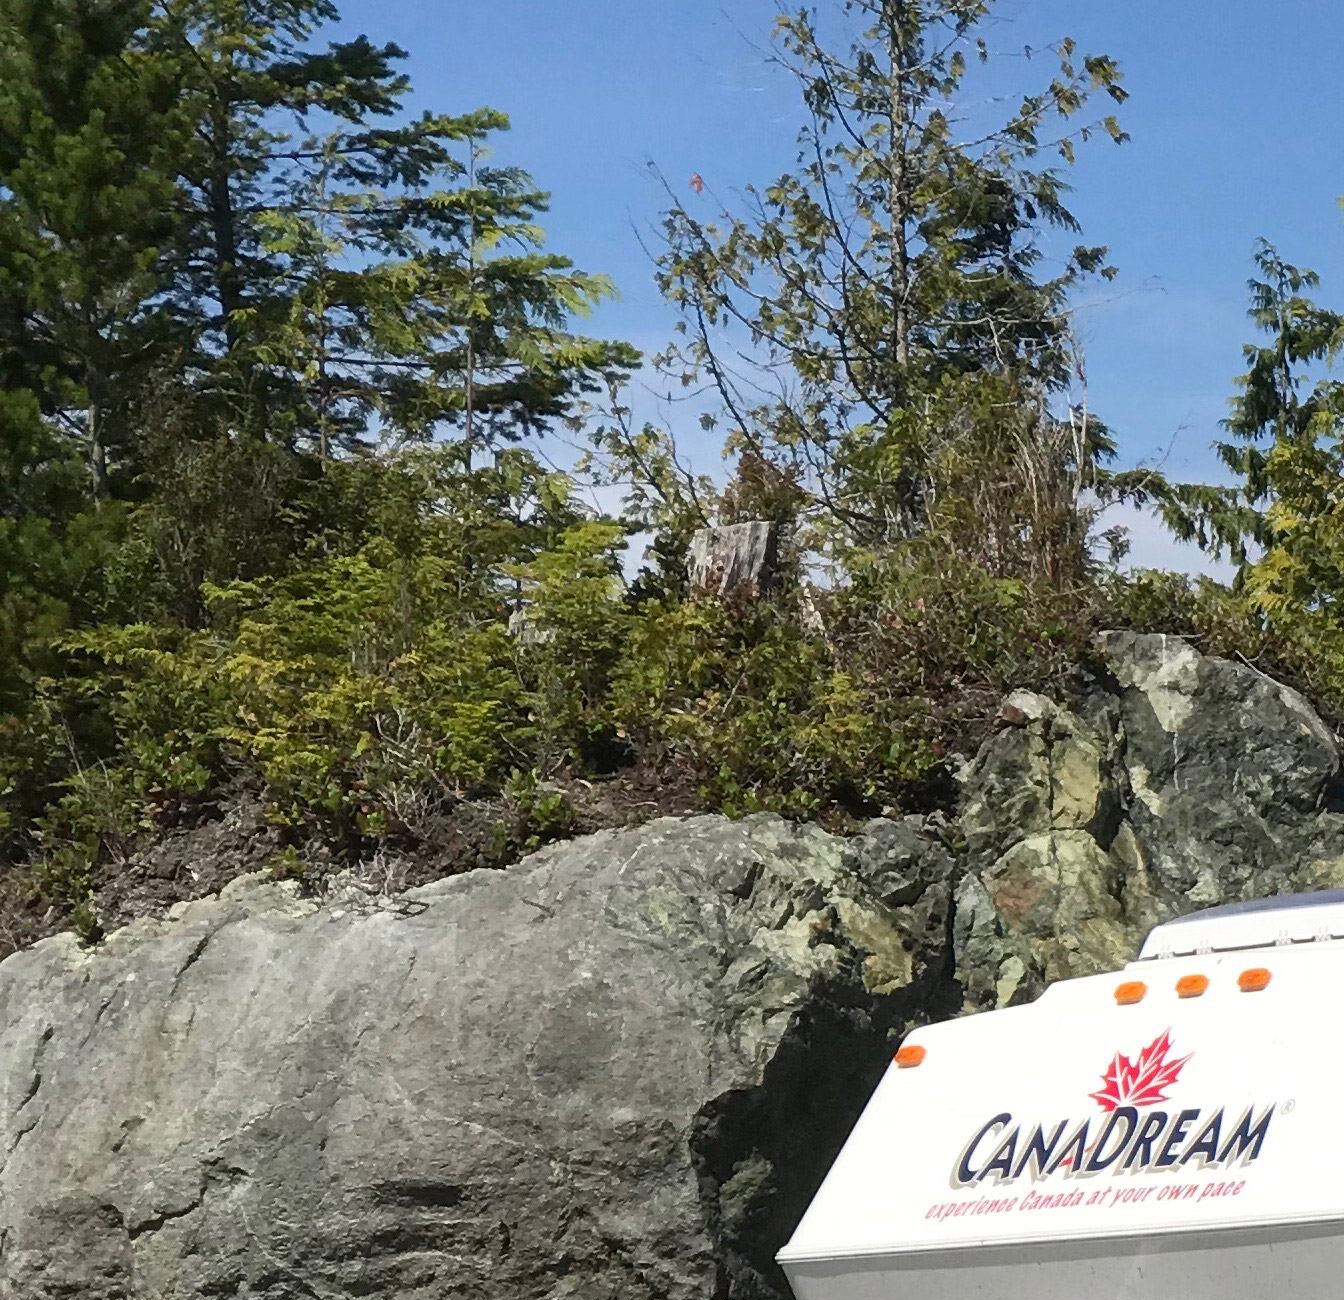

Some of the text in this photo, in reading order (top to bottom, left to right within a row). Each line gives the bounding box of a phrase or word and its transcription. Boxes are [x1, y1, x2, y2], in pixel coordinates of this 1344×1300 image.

[925, 1180, 1247, 1222] experience Canada at your own pace
